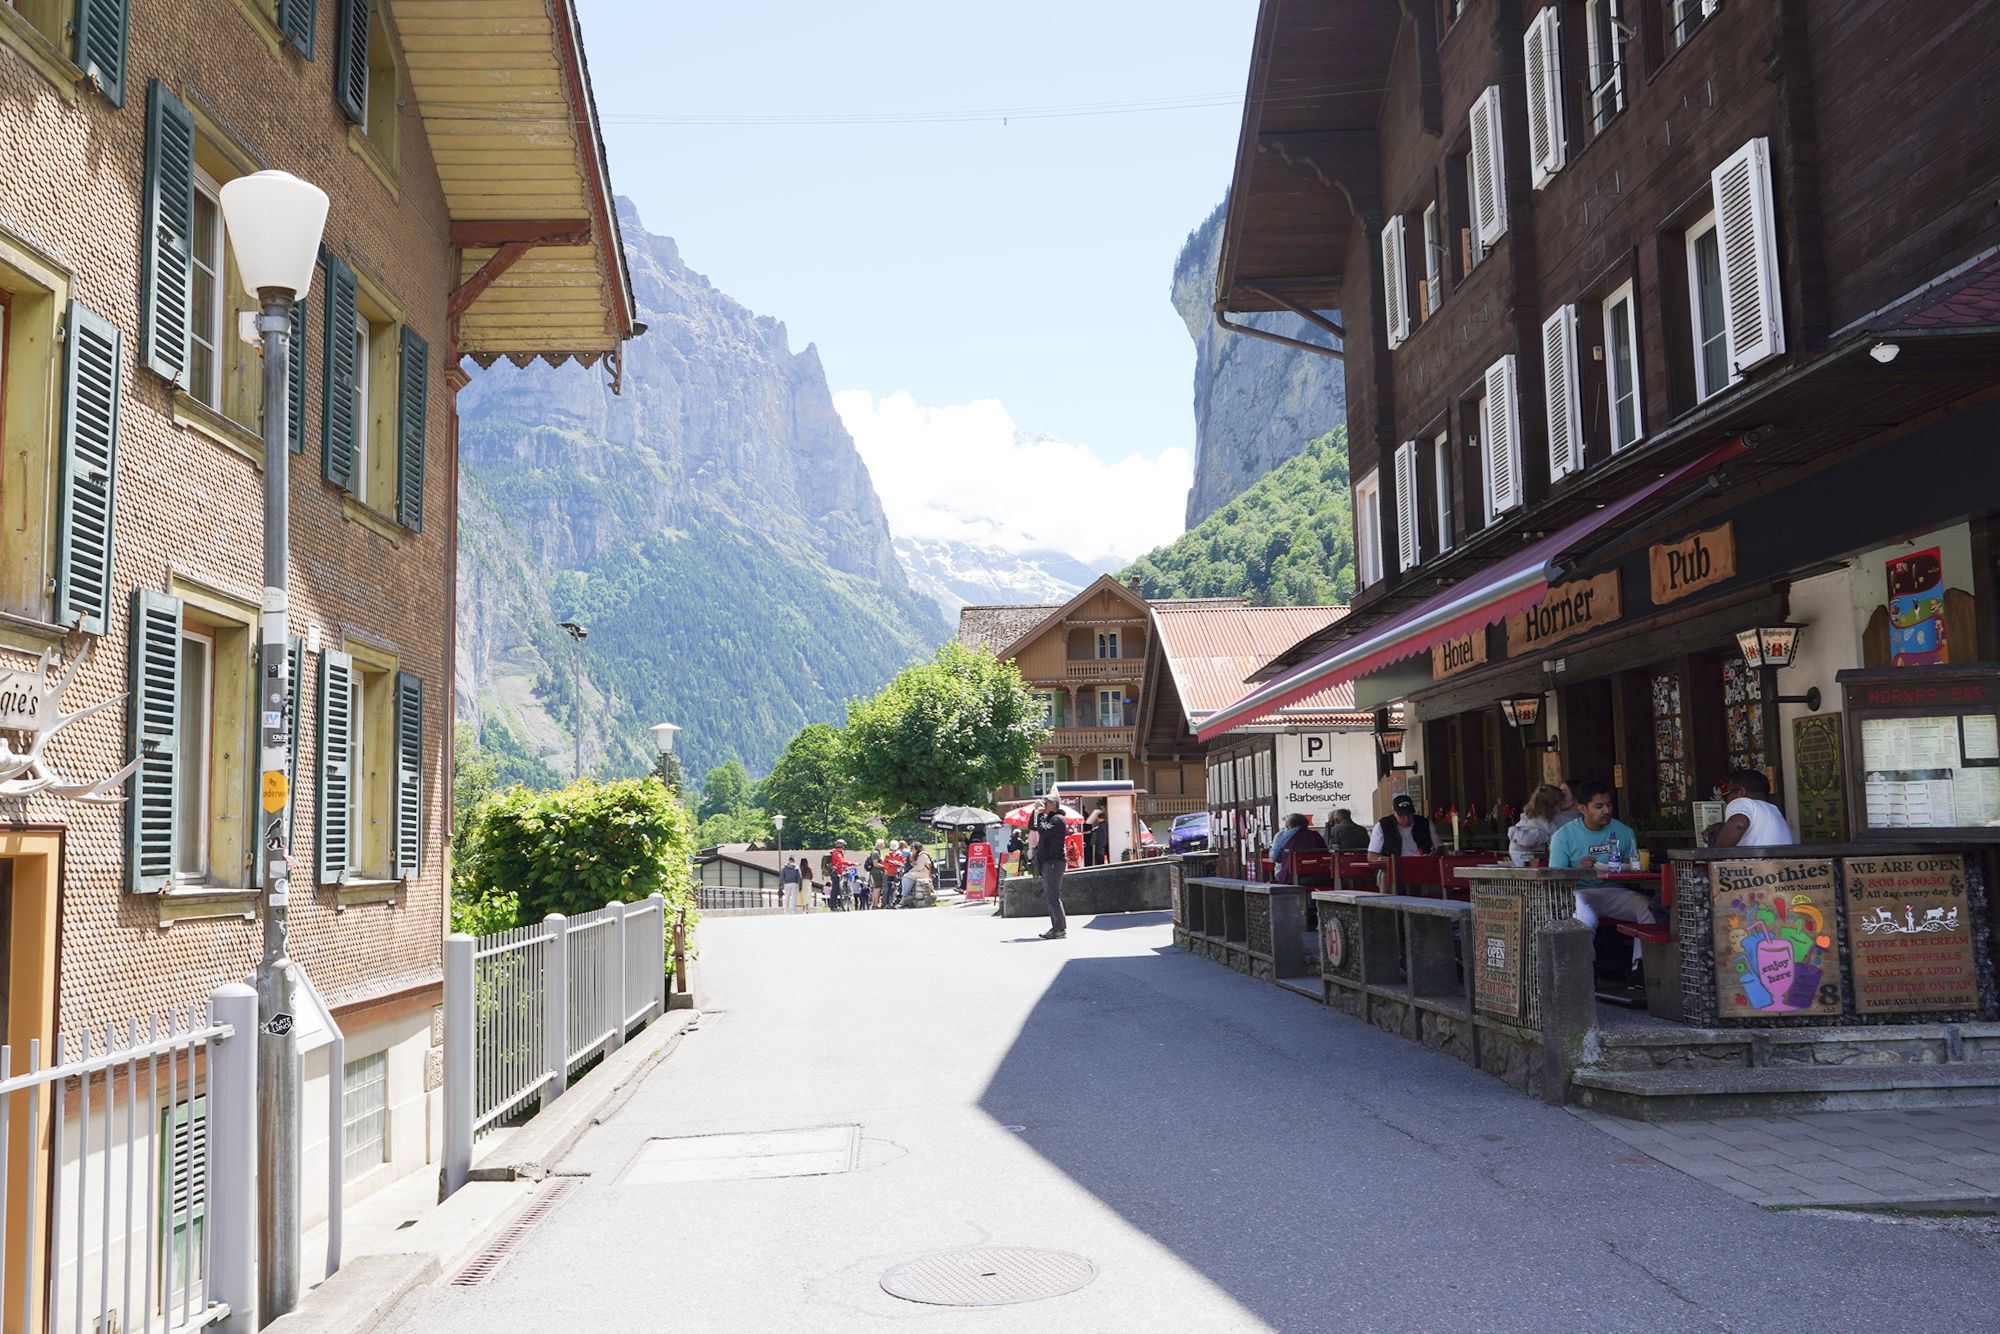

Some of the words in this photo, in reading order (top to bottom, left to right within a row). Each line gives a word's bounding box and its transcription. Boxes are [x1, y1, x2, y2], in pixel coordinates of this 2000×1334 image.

[1667, 536, 1711, 590] Pub
[1525, 585, 1594, 643] Horner
[1442, 635, 1474, 672] Hotel
[1308, 737, 1323, 758] P
[1298, 769, 1314, 777] nur
[1321, 767, 1335, 777] für
[1290, 779, 1344, 791] Hotelgäste
[1718, 866, 1754, 877] Fruit
[1850, 863, 1876, 874] WE
[1881, 861, 1913, 873] ARE
[1917, 859, 1960, 872] OPEN
[1718, 863, 1829, 893] Smoothies
[1797, 882, 1831, 891] Natural
[1866, 891, 1881, 899] All
[1904, 889, 1930, 898] every
[1932, 888, 1949, 897] day
[1856, 939, 1898, 949] COFFEE
[1899, 937, 1908, 947] &
[1910, 937, 1928, 946] ICE
[1930, 935, 1969, 946] CREAM
[1866, 954, 1904, 964] HOUSE
[1906, 952, 1962, 962] SPECIALS
[1762, 959, 1789, 974] enjoy
[1868, 968, 1911, 978] SNACKS
[1914, 967, 1923, 977] &
[1926, 966, 1963, 977] APERO
[1768, 970, 1791, 984] here
[1818, 983, 1840, 1006] 8
[1863, 984, 1894, 994] COLD
[1897, 983, 1927, 993] BEER
[1929, 982, 1944, 991] ON
[1947, 981, 1970, 990] TAP
[1865, 999, 1889, 1008] TAKE
[1893, 997, 1918, 1006] AWAY
[1921, 995, 1972, 1004] AVAILABLE
